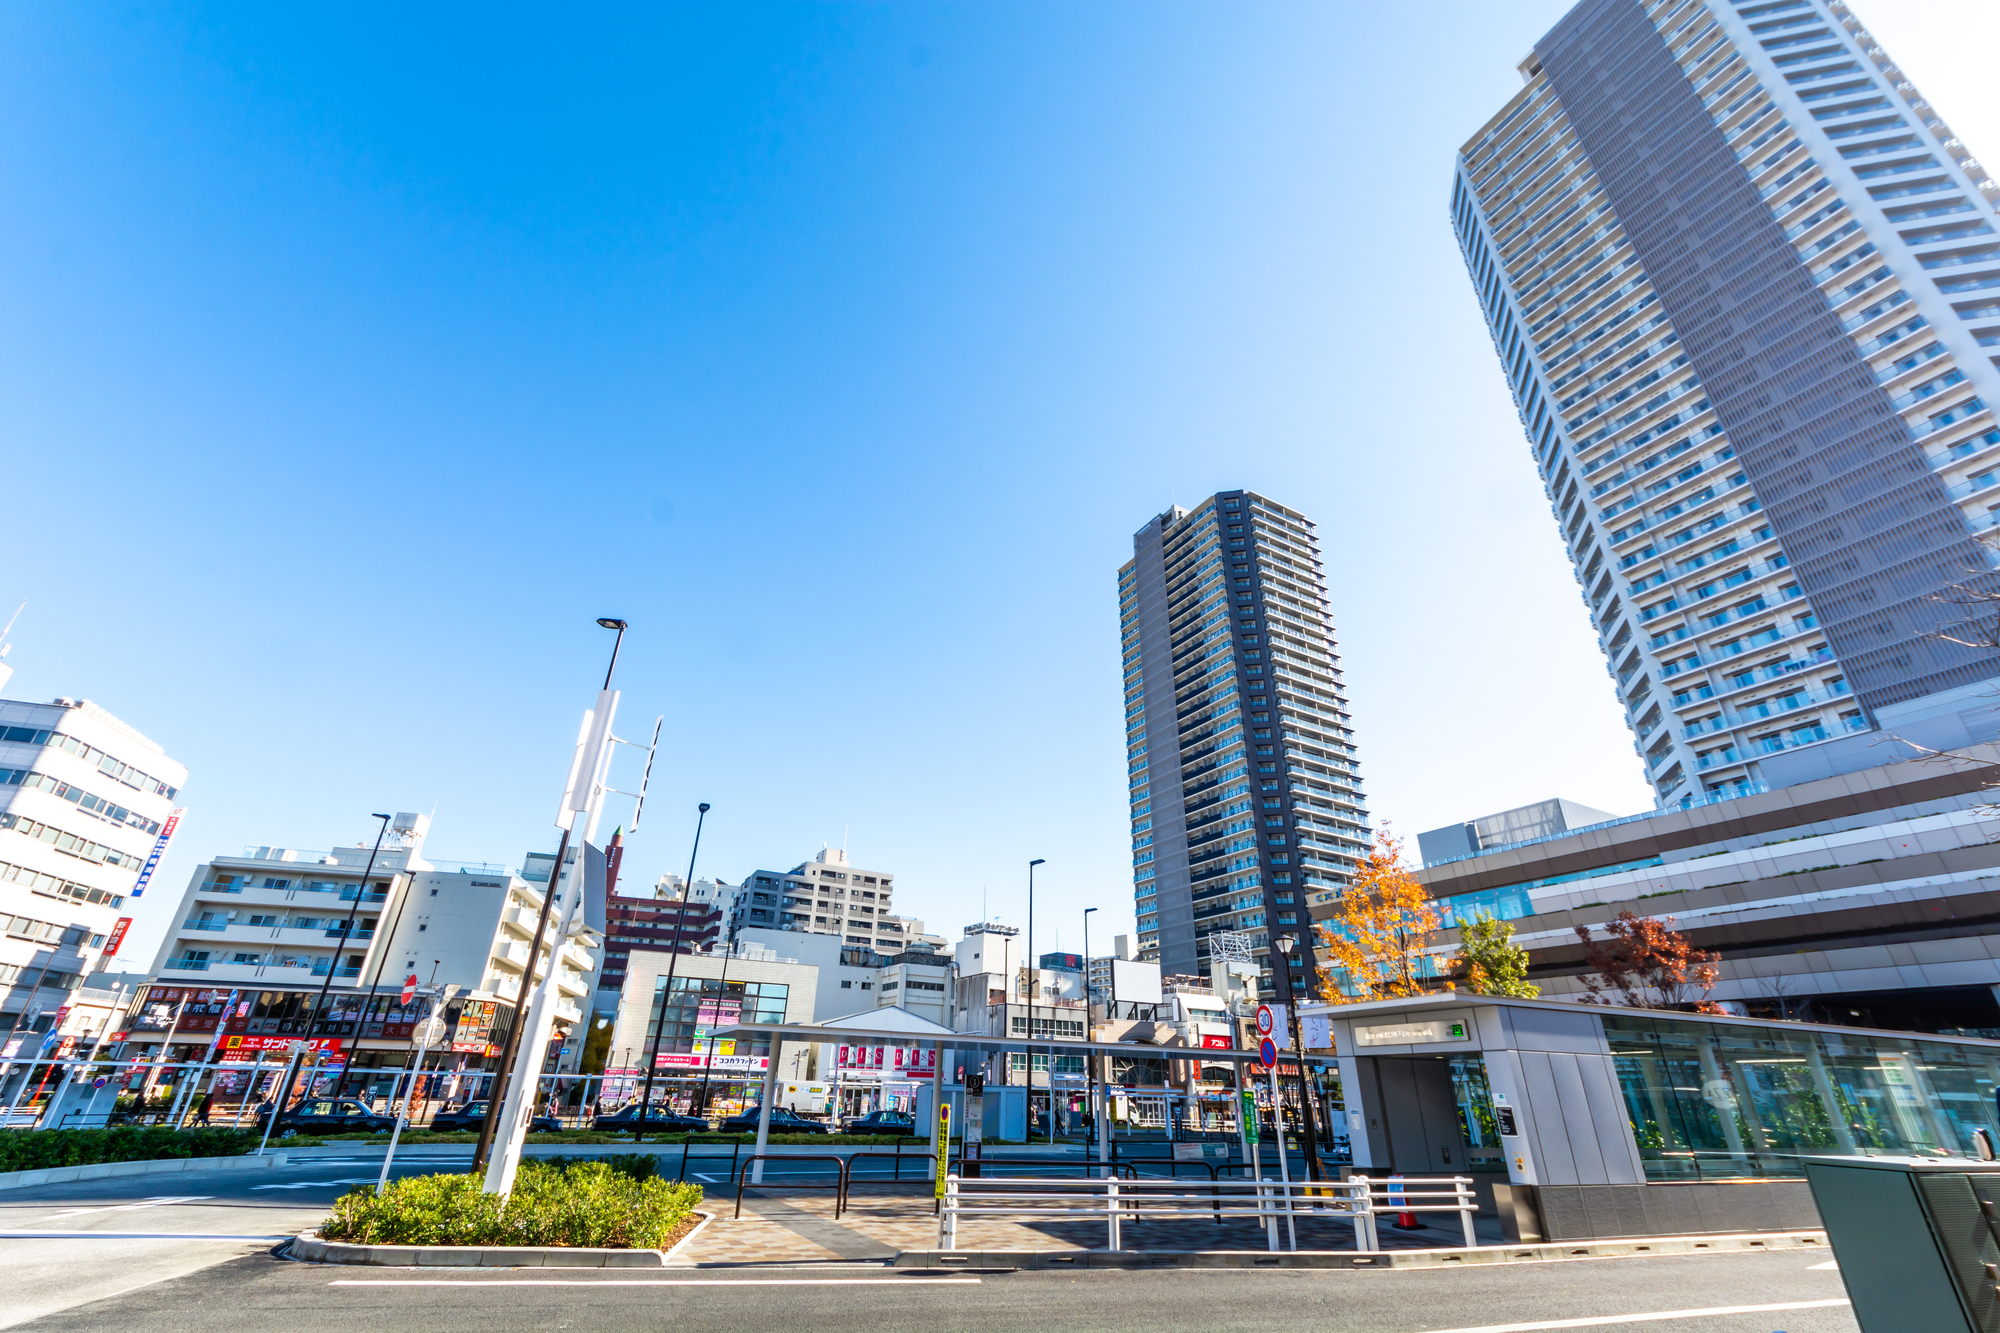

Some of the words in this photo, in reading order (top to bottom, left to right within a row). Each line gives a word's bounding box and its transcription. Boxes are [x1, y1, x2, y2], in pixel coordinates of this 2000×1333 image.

[1260, 1013, 1270, 1028] 30
[1210, 1039, 1225, 1047] アコム
[841, 1050, 883, 1059] DAISO
[896, 1052, 936, 1061] DAISO
[719, 1057, 760, 1065] ココカラファイン
